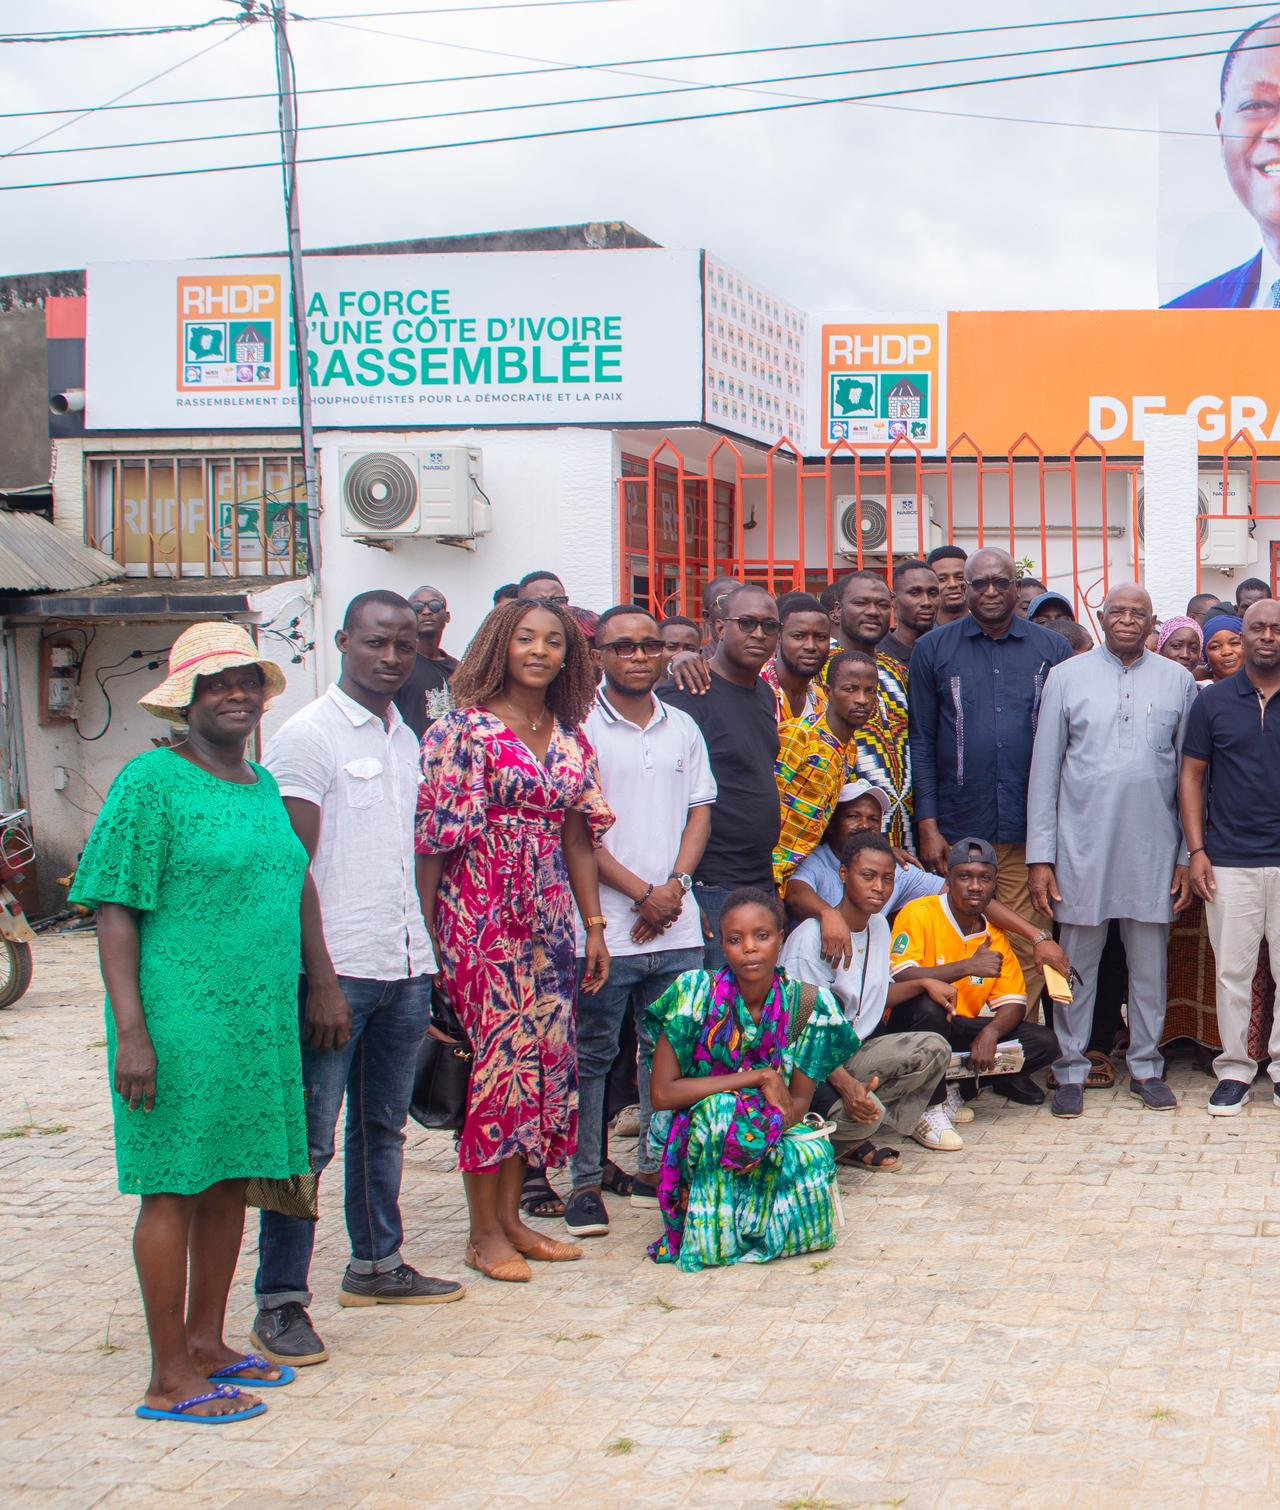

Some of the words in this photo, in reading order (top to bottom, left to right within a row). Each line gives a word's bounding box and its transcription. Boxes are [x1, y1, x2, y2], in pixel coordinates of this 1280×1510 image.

[183, 284, 275, 315] RHDP
[339, 289, 450, 317] FORCE
[392, 316, 477, 344] CÔTE
[487, 316, 622, 342] D'IVOIRE
[828, 335, 932, 365] RHDP
[289, 342, 623, 388] RASSEMBLÉE
[176, 397, 278, 407] RASSEMBLEMENT
[419, 394, 452, 404] POUR
[457, 394, 471, 403] LA
[475, 392, 553, 403] DÉMOCRATIE
[557, 393, 572, 402] ET
[576, 393, 591, 401] LA
[595, 392, 623, 401] PAIX
